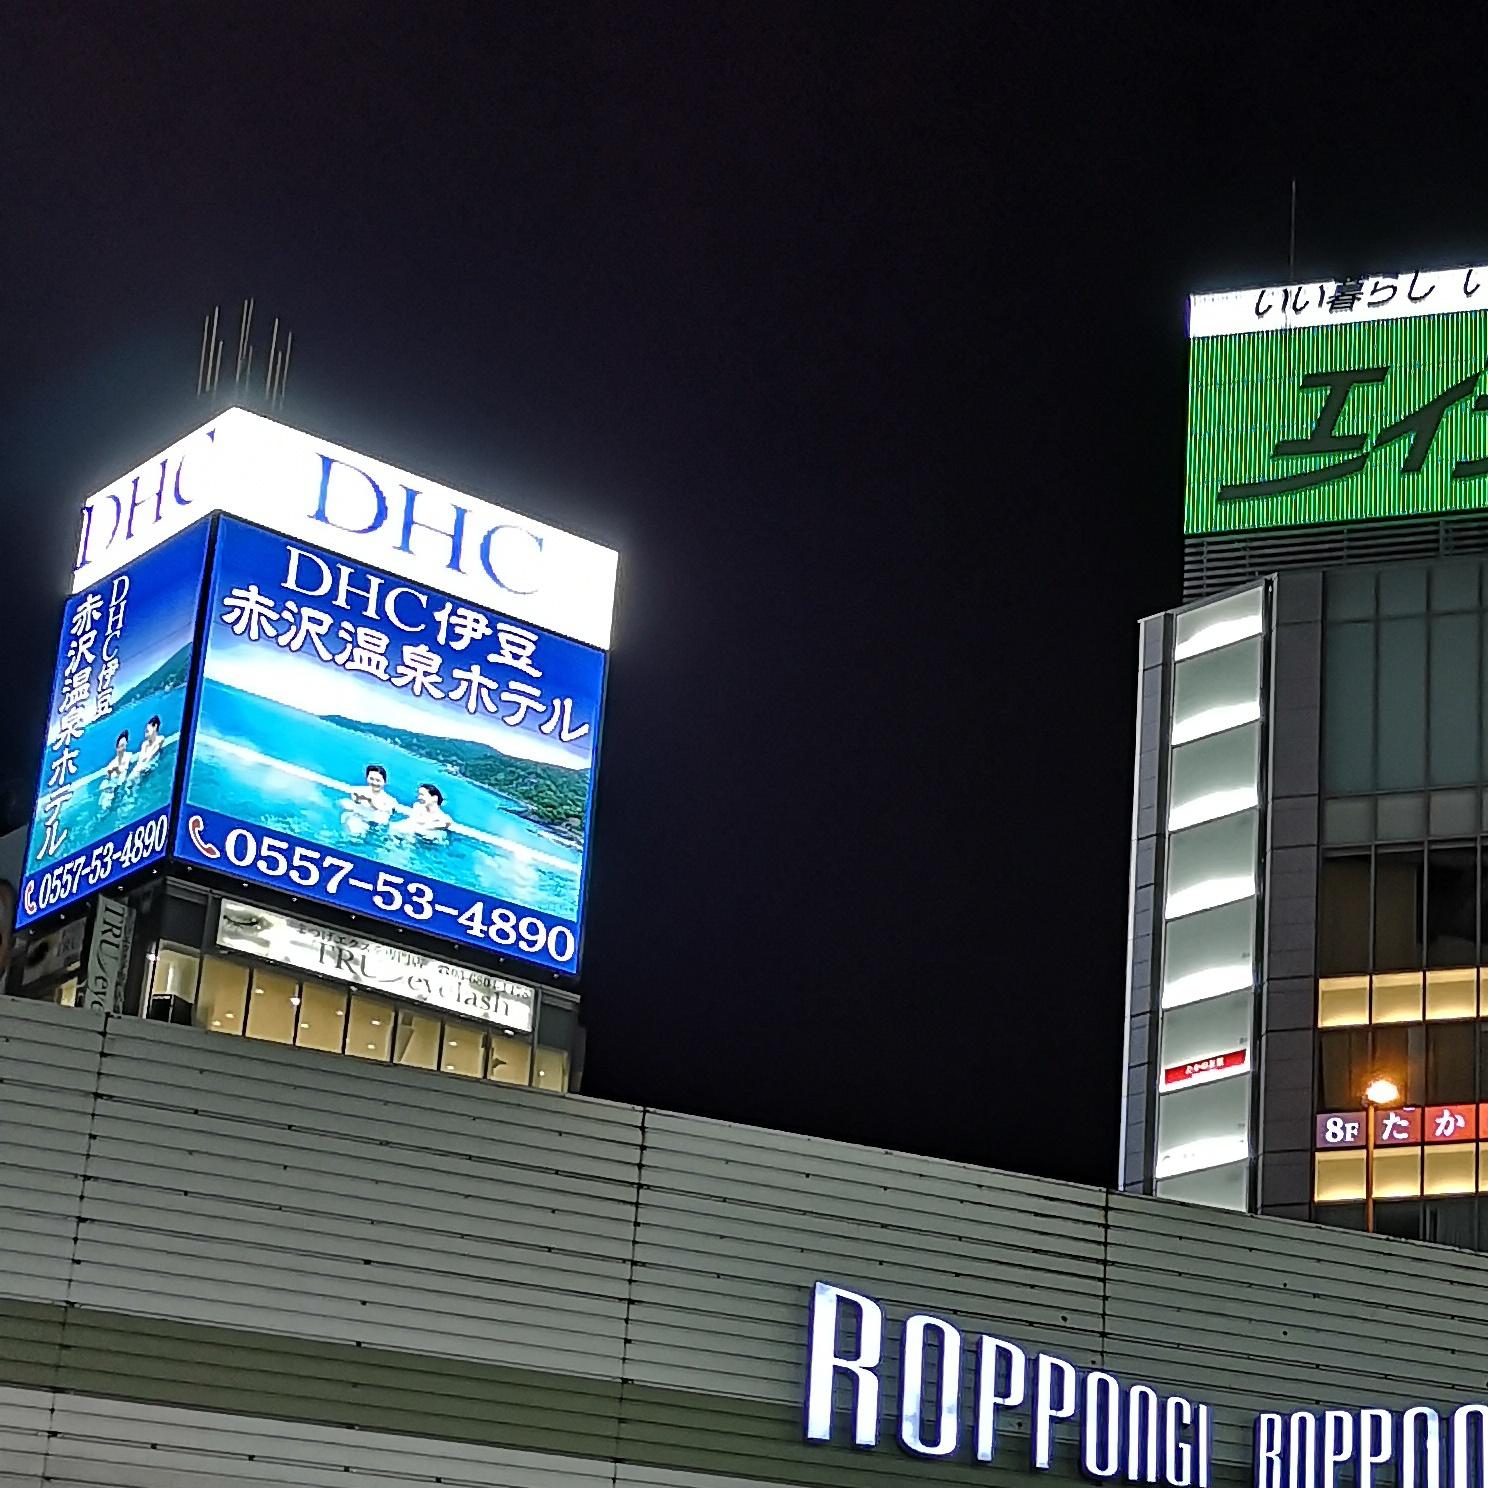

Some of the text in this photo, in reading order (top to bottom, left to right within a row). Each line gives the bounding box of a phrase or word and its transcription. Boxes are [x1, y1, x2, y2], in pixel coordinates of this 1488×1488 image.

[1254, 269, 1436, 317] いい暮らし
[306, 452, 544, 597] DHC
[94, 575, 130, 721] DHC伊豆
[222, 584, 591, 745] 赤沢温泉ホテル
[279, 545, 544, 679] DHC伊豆
[37, 592, 104, 861] 赤沢温泉ホテル
[39, 814, 170, 909] 0557-53-4890
[224, 827, 577, 964] 0557-53-4890
[1325, 1118, 1360, 1144] 8F
